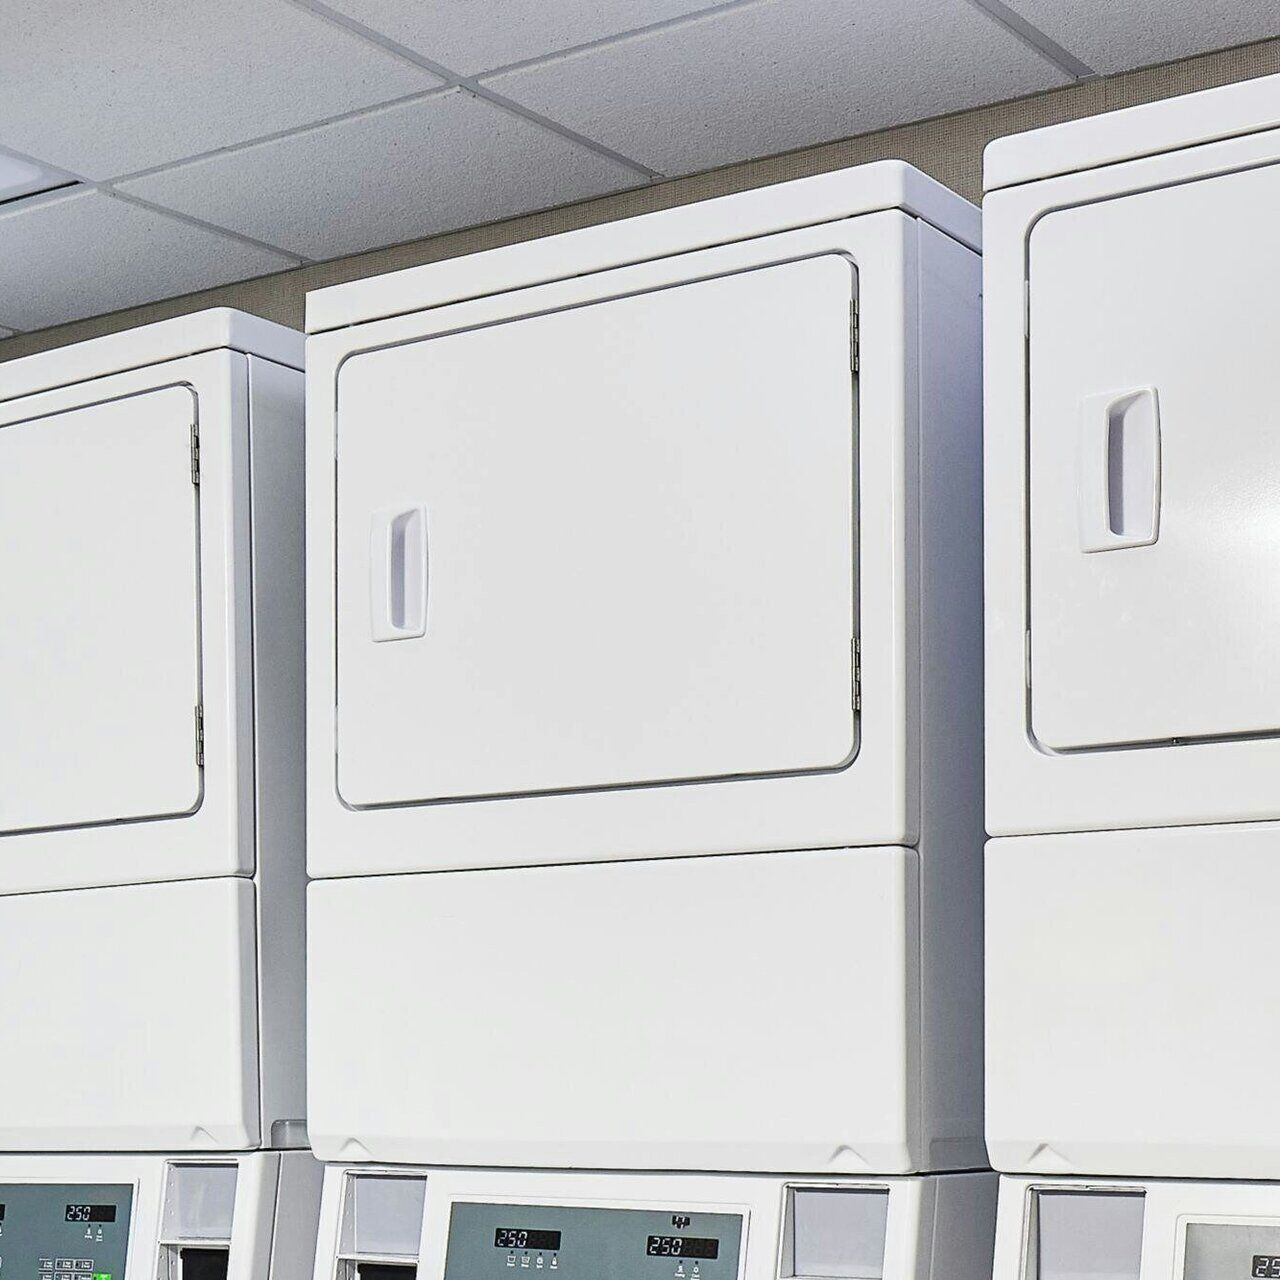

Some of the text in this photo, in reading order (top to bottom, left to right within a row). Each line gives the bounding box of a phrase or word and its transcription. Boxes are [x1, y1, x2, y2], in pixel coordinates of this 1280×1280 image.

[67, 1206, 91, 1220] 250
[498, 1231, 528, 1247] 250
[650, 1238, 682, 1255] 250
